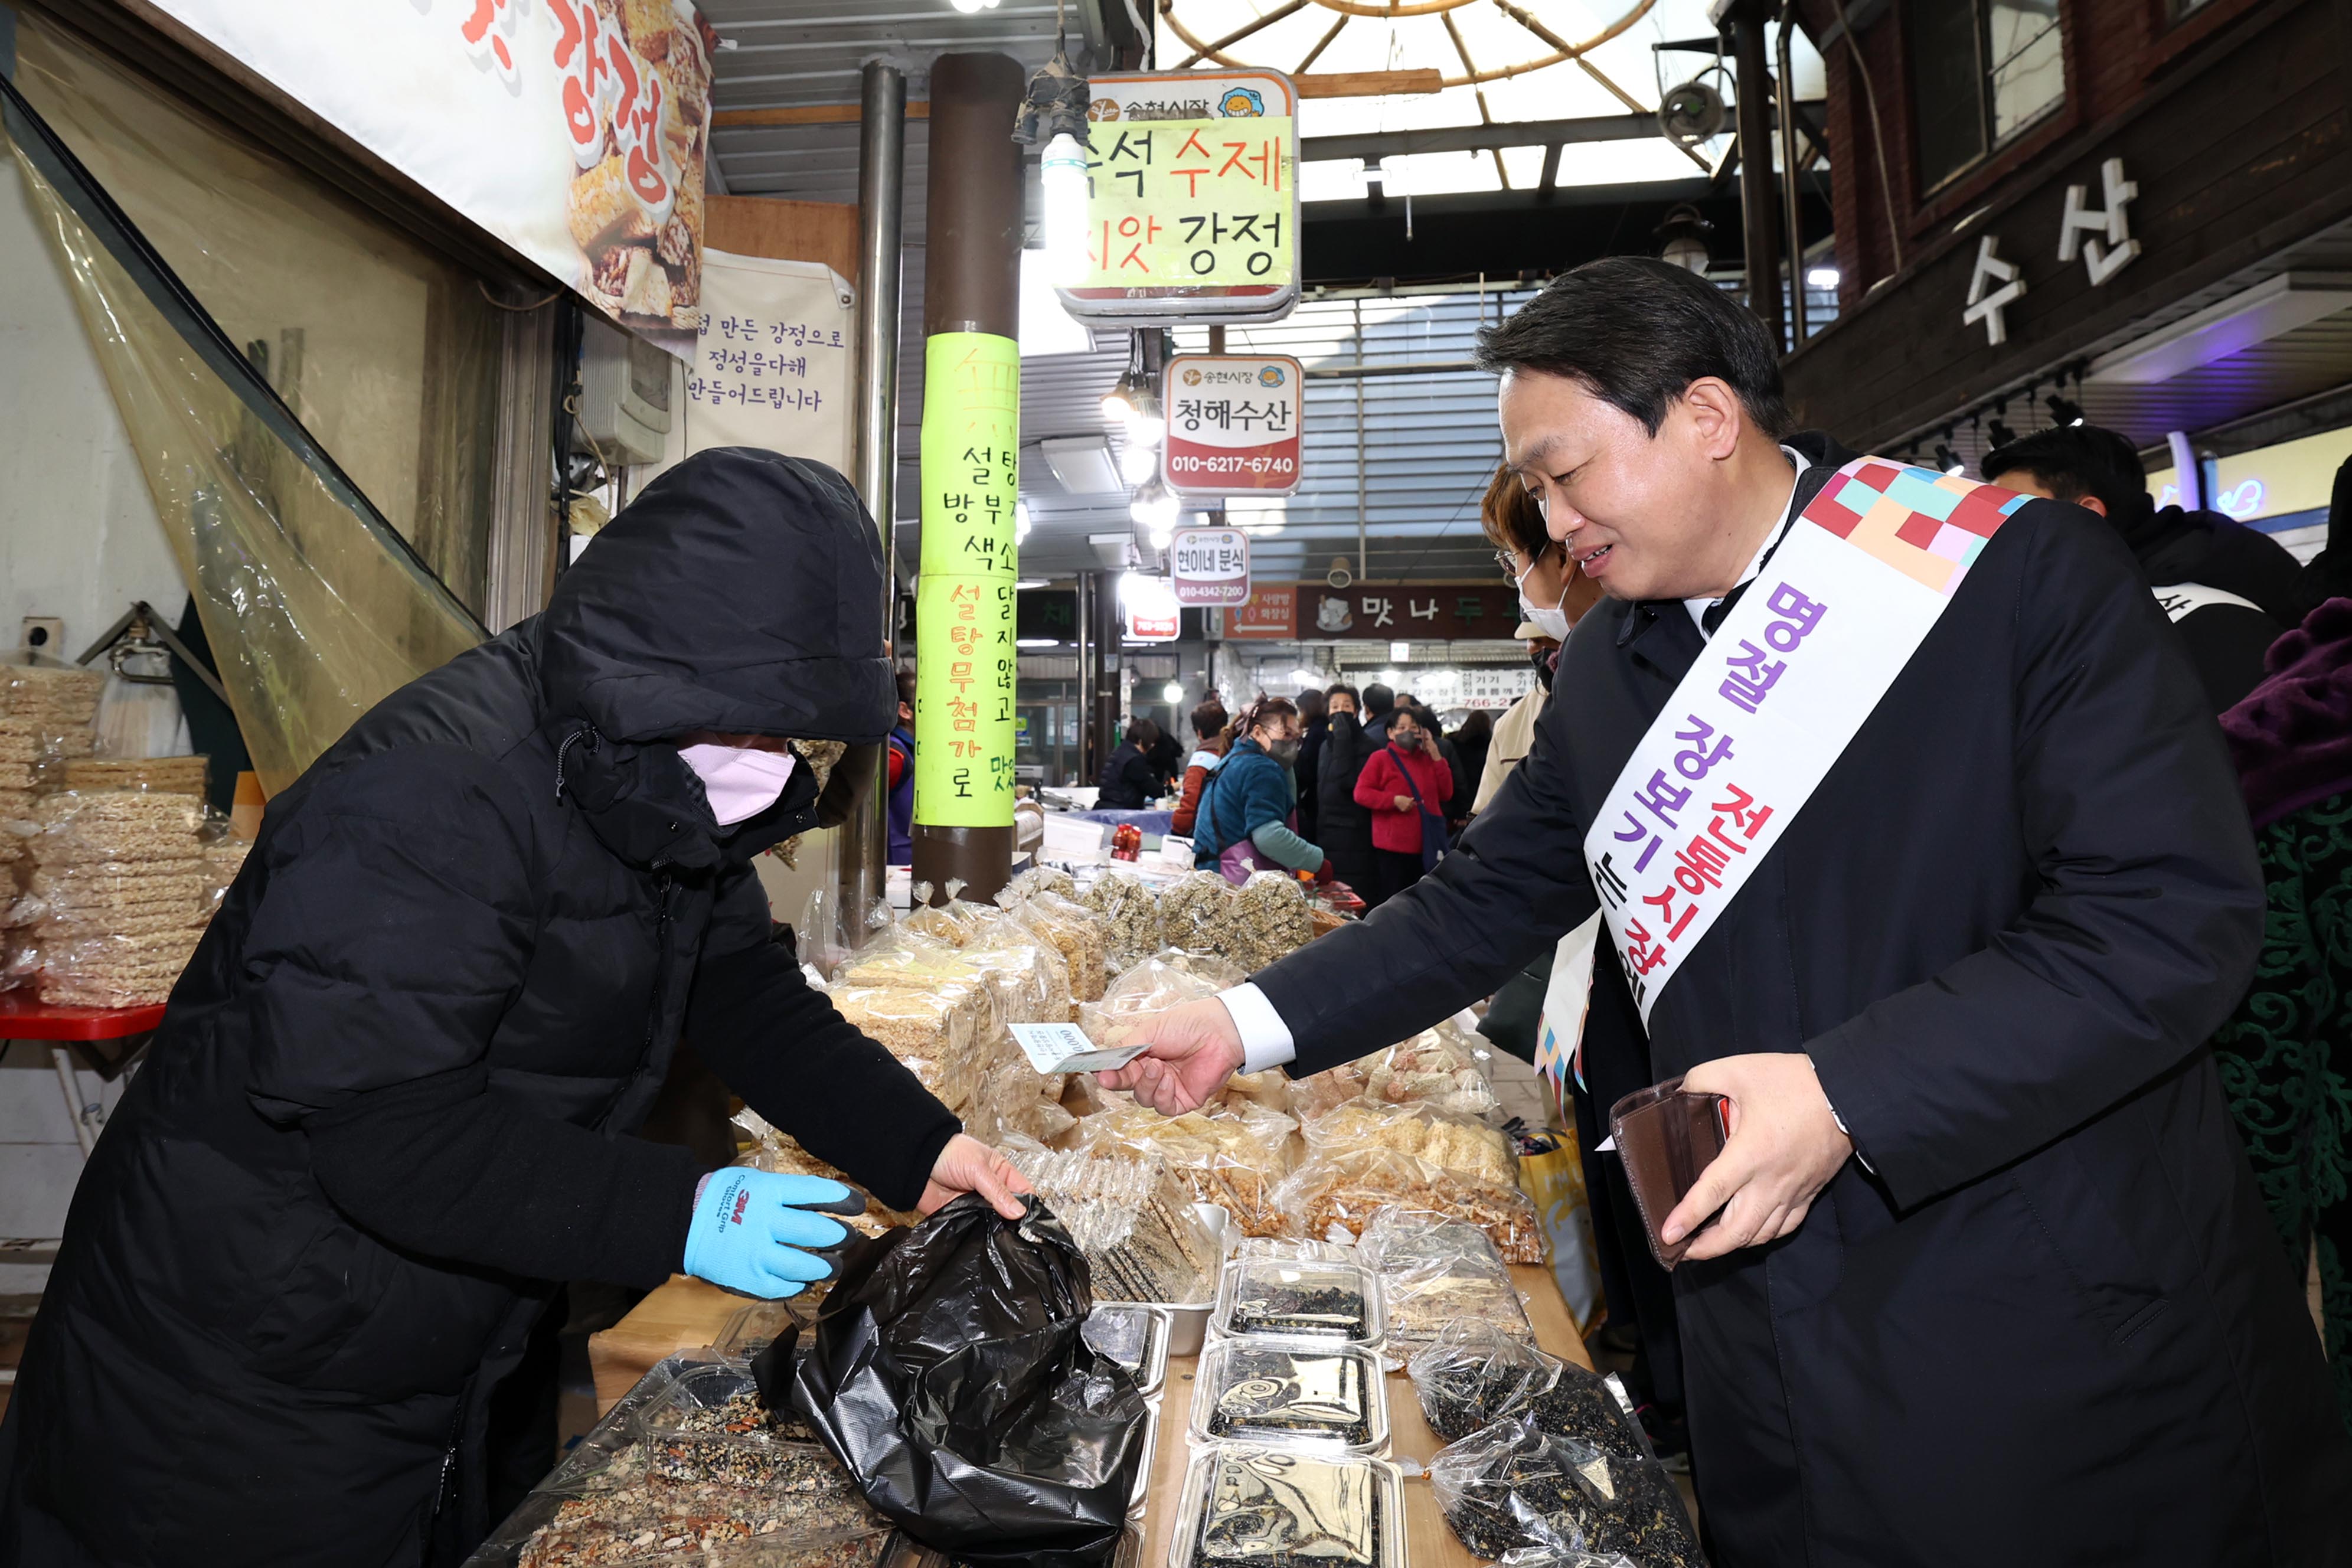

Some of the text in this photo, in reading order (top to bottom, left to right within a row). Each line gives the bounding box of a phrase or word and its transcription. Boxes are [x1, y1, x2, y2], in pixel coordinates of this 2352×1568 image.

[1170, 128, 1280, 198] 수제
[1179, 212, 1280, 276] 강정
[720, 316, 758, 341] 만든
[769, 322, 844, 348] 강정으로
[709, 348, 806, 378] 정성을다해
[1204, 371, 1253, 384] 송현시장
[688, 378, 822, 412] 만들어드립니다
[1175, 399, 1292, 431] 청해수산
[963, 447, 1017, 486] 설탕
[1172, 456, 1293, 473] 010-6217-6740
[965, 535, 1015, 571] 색소
[1178, 549, 1244, 572] 현이네 분식
[1180, 586, 1243, 597] 010-4342-7200
[1261, 608, 1289, 619] 화장실
[1717, 581, 1828, 714] 명절
[1594, 714, 1734, 911] 장보기는
[716, 1185, 731, 1218] Gloves
[718, 1174, 746, 1233] Comfort Grip
[731, 1188, 750, 1226] 3M
